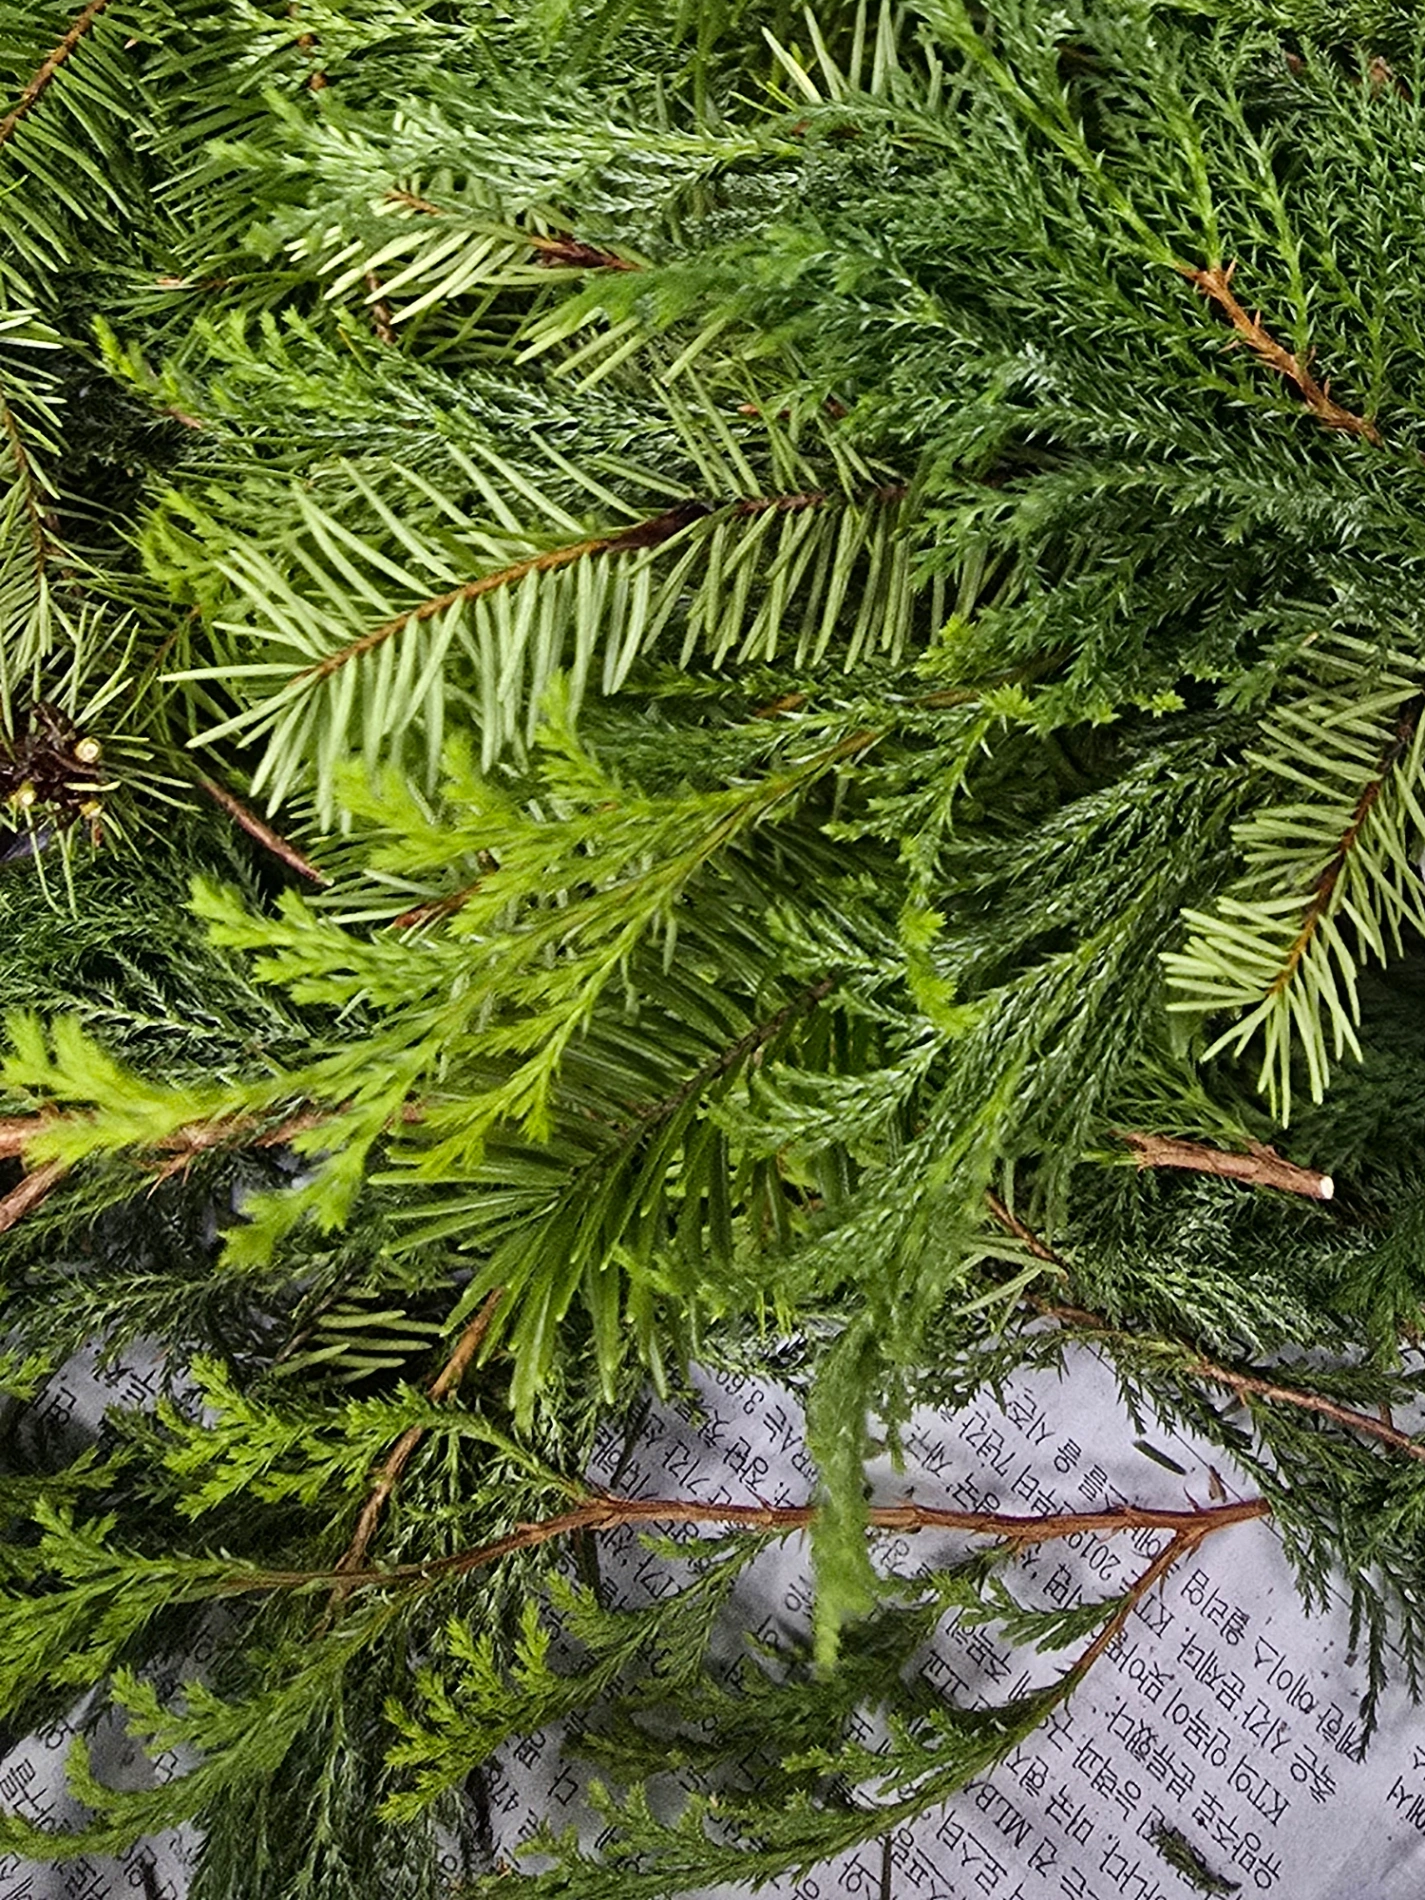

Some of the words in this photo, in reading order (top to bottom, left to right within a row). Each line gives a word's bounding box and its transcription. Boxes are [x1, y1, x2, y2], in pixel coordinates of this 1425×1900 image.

[956, 1409, 1020, 1478] 7년간
[1000, 1392, 1057, 1448] 시즌
[661, 1438, 709, 1495] 기간
[723, 1436, 769, 1494] 장단
[1050, 1437, 1084, 1475] 올
[1180, 1568, 1251, 1646] 윌리엄
[1172, 1625, 1249, 1712] 문제다.
[1248, 1634, 1323, 1716] 에이스
[1105, 1696, 1196, 1803] 분류했다.
[1159, 1686, 1235, 1769] 안목이
[1238, 1696, 1294, 1758] 시간
[1072, 1737, 1141, 1822] 능력과
[1227, 1753, 1291, 1827] KT의
[1286, 1743, 1340, 1805] 축은
[1042, 1783, 1099, 1847] 미국
[1192, 1790, 1282, 1890] 유망주로
[936, 1810, 1008, 1896] 로스터
[1026, 1836, 1061, 1879] 건
